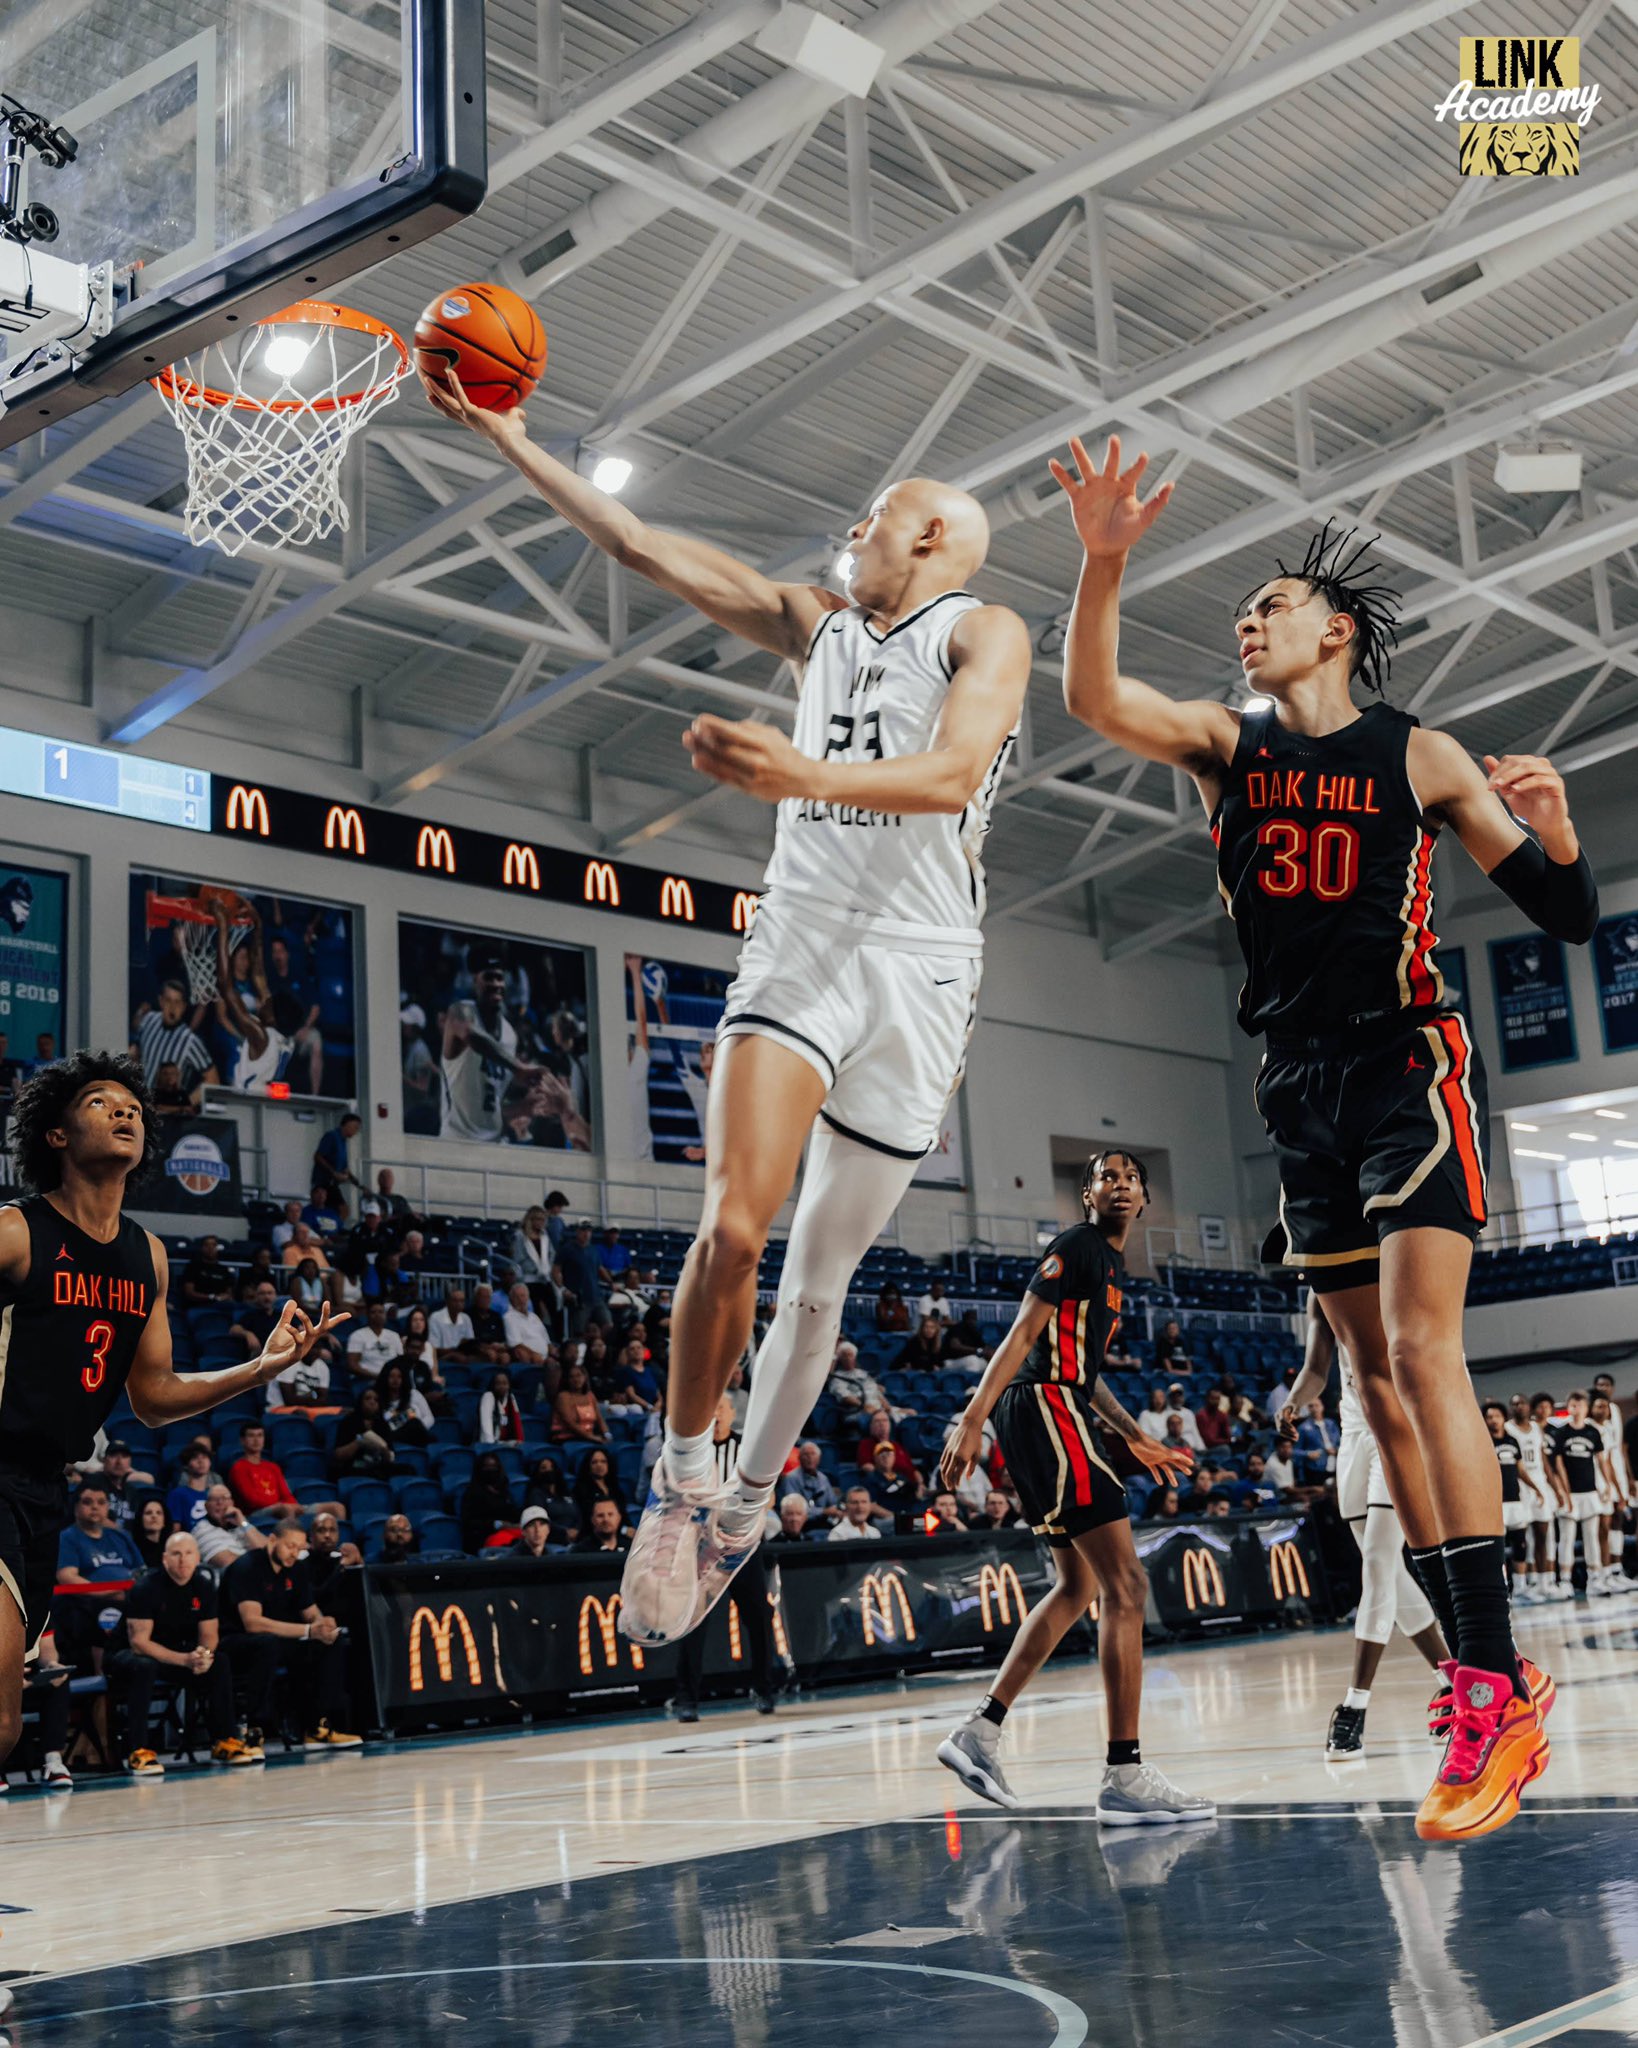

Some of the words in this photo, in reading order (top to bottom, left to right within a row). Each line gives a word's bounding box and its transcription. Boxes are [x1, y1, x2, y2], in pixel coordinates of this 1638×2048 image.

[53, 747, 69, 780] 1
[1247, 770, 1306, 809] OAK
[1316, 774, 1381, 814] HILL
[1257, 818, 1360, 902] 30
[15, 983, 59, 1004] 2019
[54, 1271, 103, 1309] OAK
[108, 1277, 147, 1318] HILL
[80, 1319, 116, 1392] 3
